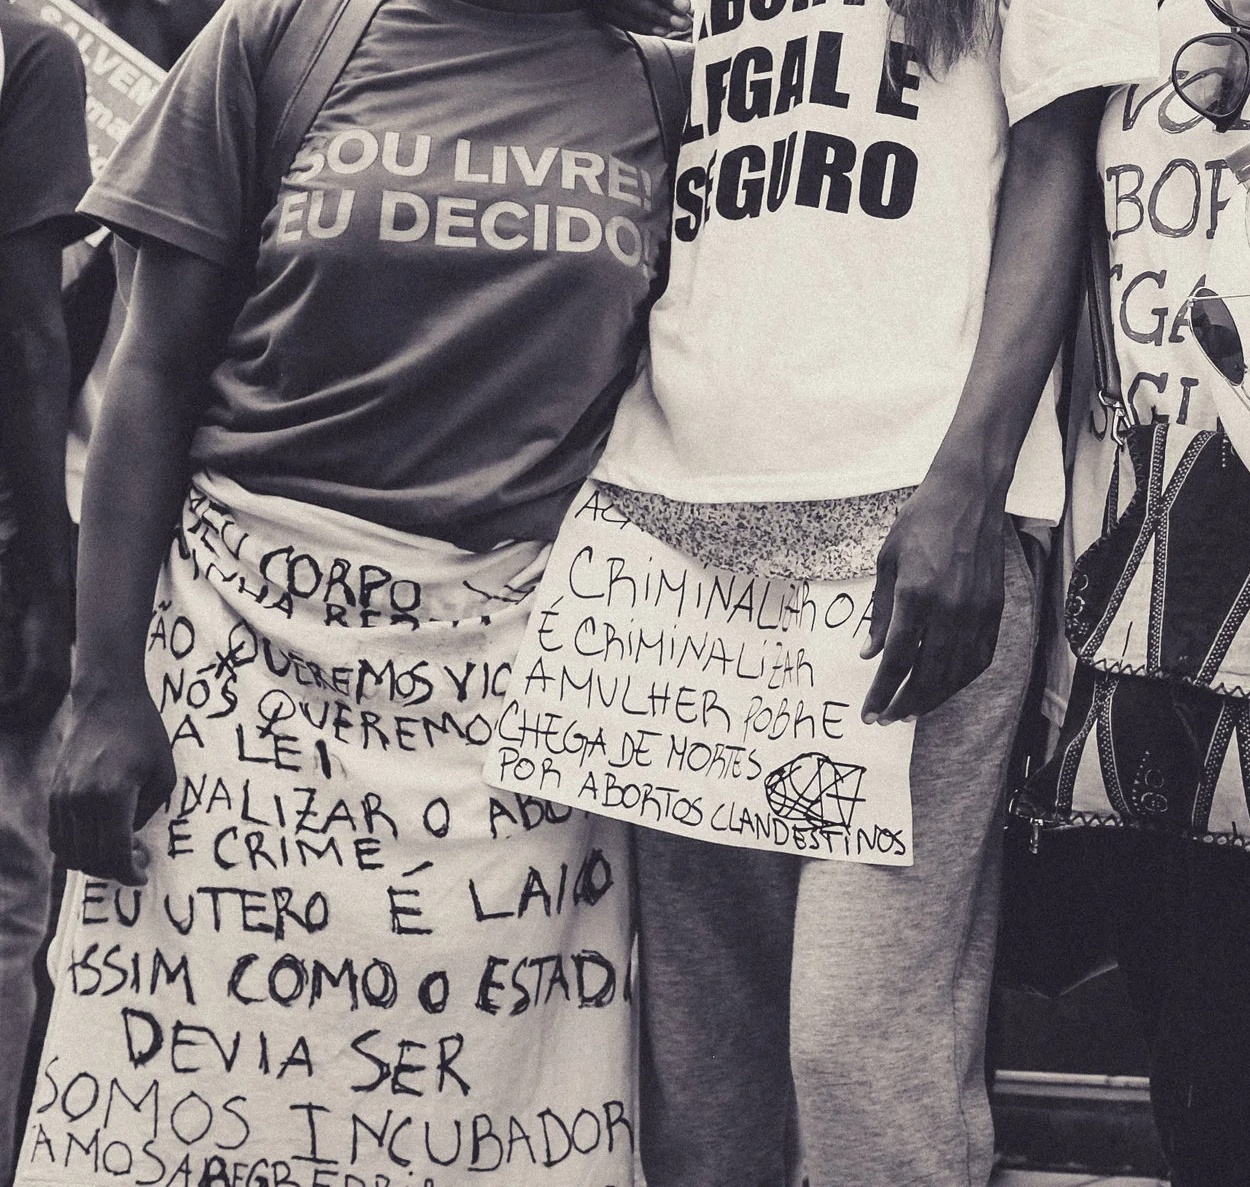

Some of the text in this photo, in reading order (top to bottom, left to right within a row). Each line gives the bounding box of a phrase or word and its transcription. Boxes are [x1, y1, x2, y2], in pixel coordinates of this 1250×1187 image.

[876, 40, 921, 121] E
[294, 127, 652, 212] SOU LIVRE!
[278, 187, 649, 279] EU DECIDO!
[260, 545, 422, 612] CORPO
[825, 592, 855, 629] O
[149, 600, 196, 661] ÃO
[443, 661, 512, 703] VIC
[537, 594, 566, 653] É
[171, 713, 333, 779] A LEI
[255, 688, 499, 751] QUEREMO
[498, 698, 764, 781] CHEGA DE MORTES
[743, 694, 850, 744] POBRE
[165, 774, 399, 838] NALIZAR
[423, 798, 451, 839] O
[498, 746, 907, 856] POR ABORTOS CLANDESTINOS
[213, 825, 385, 871] CRIME
[82, 880, 143, 929] EU
[163, 885, 330, 941] UTERO
[386, 860, 434, 935] É
[228, 953, 399, 1011] COMO
[121, 1007, 472, 1098] DEVIA SER
[36, 1055, 635, 1173] SOMOS INCUBADOR
[29, 1123, 166, 1186] AMOS
